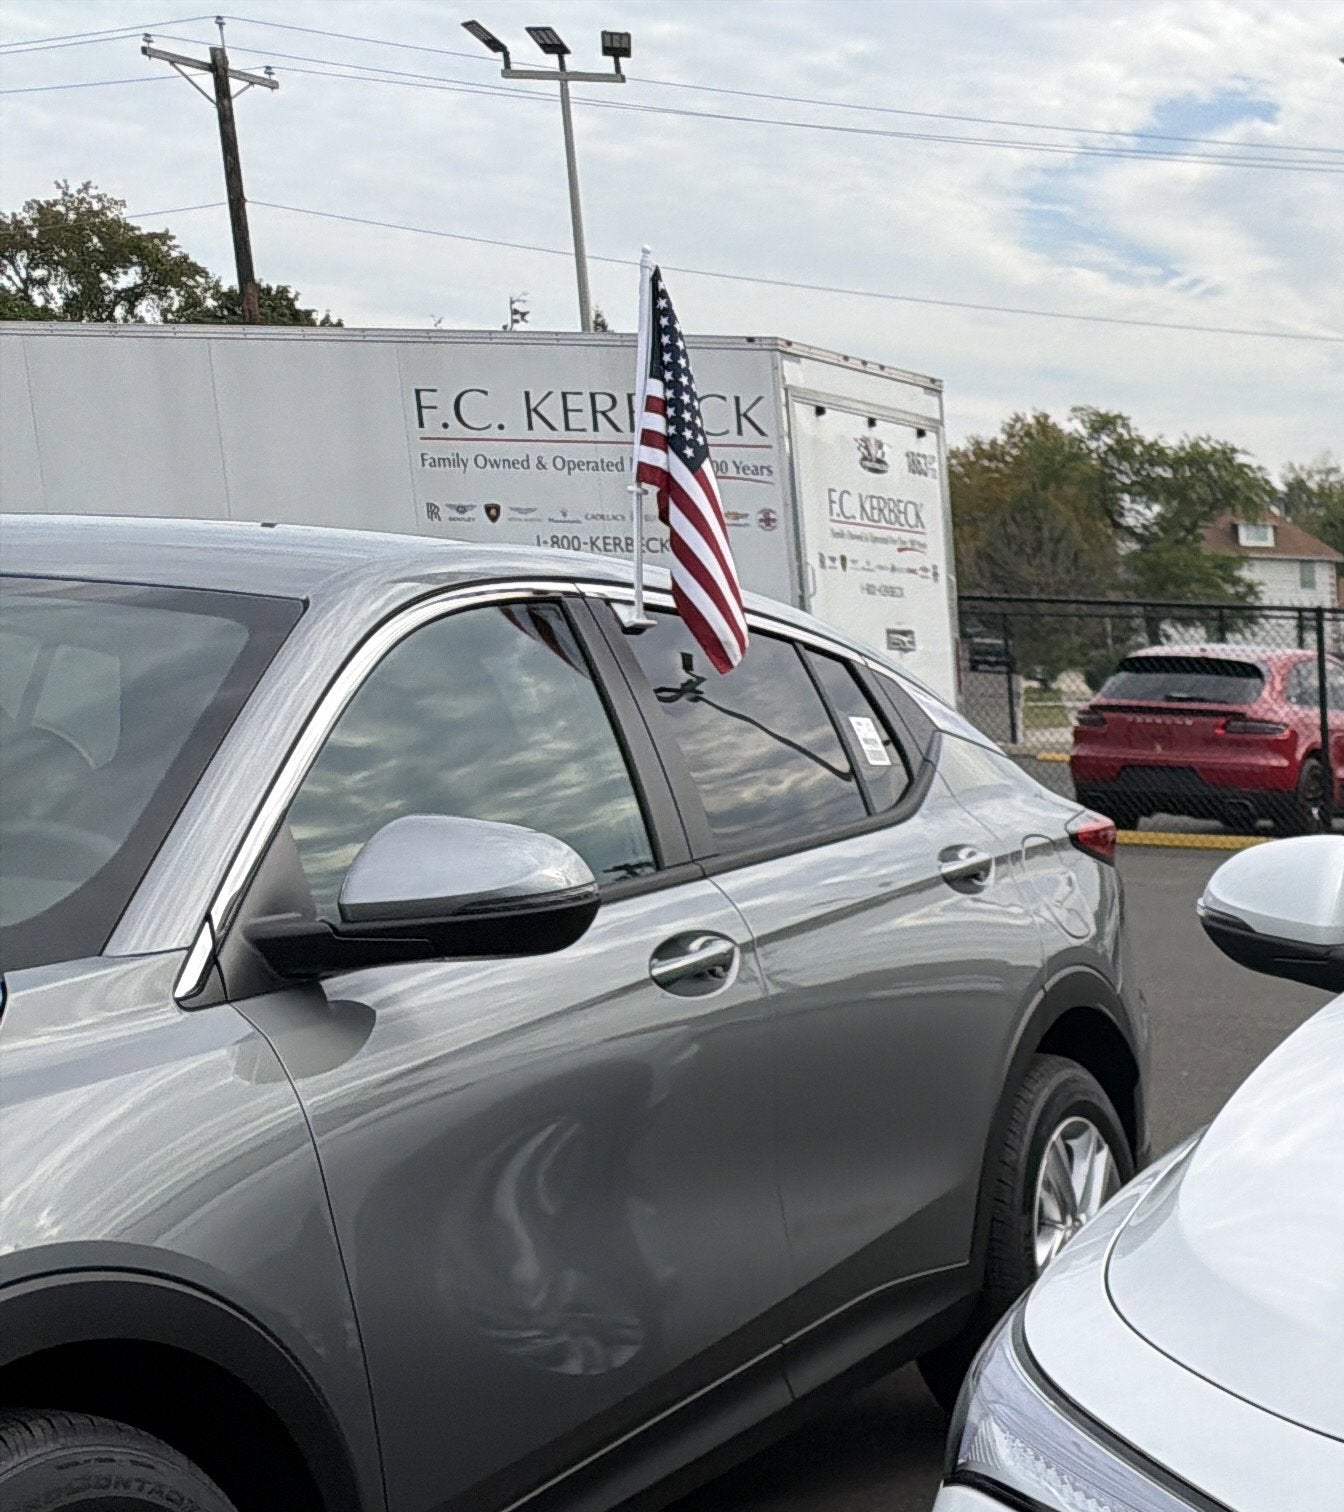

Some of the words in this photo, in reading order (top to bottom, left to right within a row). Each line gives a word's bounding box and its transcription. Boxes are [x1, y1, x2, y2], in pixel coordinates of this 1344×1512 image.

[414, 387, 505, 431] F.C.
[524, 390, 768, 437] KERCK
[420, 452, 469, 475] Family
[473, 453, 531, 471] Owned
[535, 455, 548, 471] &
[552, 455, 625, 475] Operated
[731, 459, 774, 476] Years
[827, 487, 857, 520] F.C.
[858, 492, 926, 529] KERBECK
